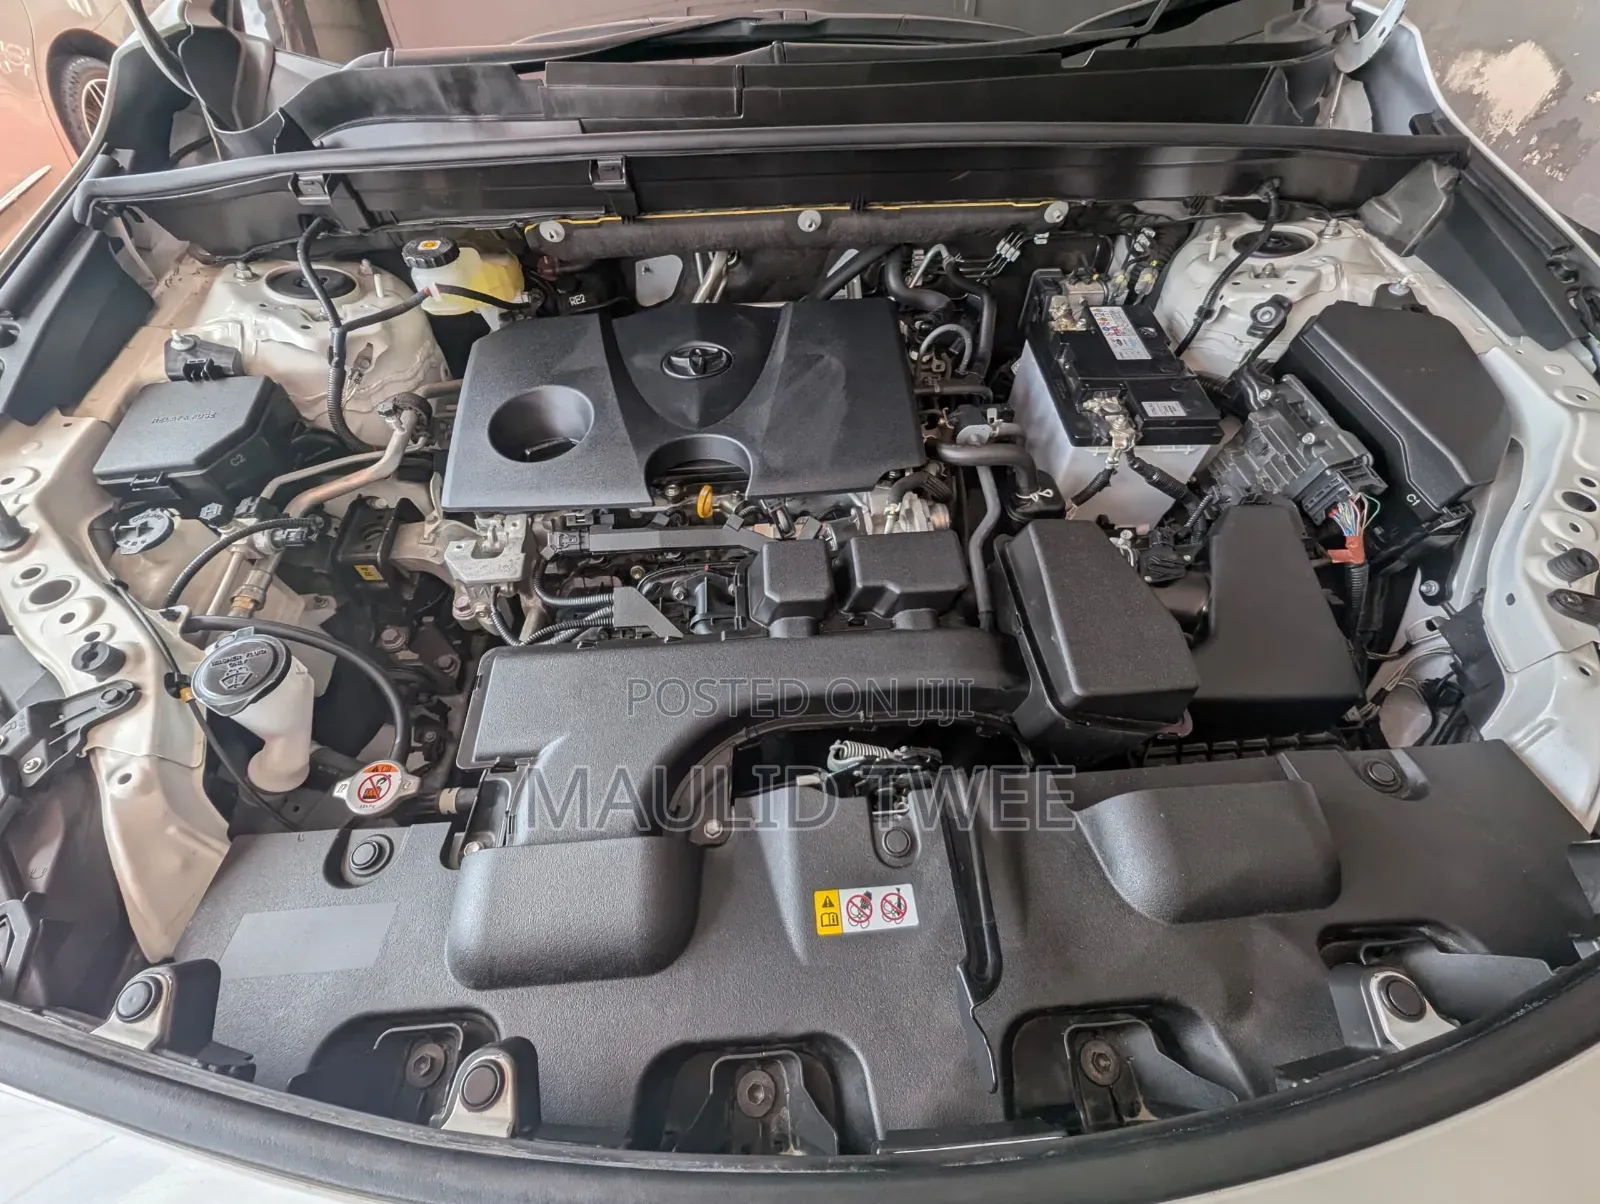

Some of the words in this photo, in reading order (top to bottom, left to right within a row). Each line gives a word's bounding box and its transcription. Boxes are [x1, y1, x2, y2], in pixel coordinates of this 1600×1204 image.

[569, 293, 586, 306] RE2
[230, 454, 246, 466] C2
[1406, 493, 1420, 506] C1
